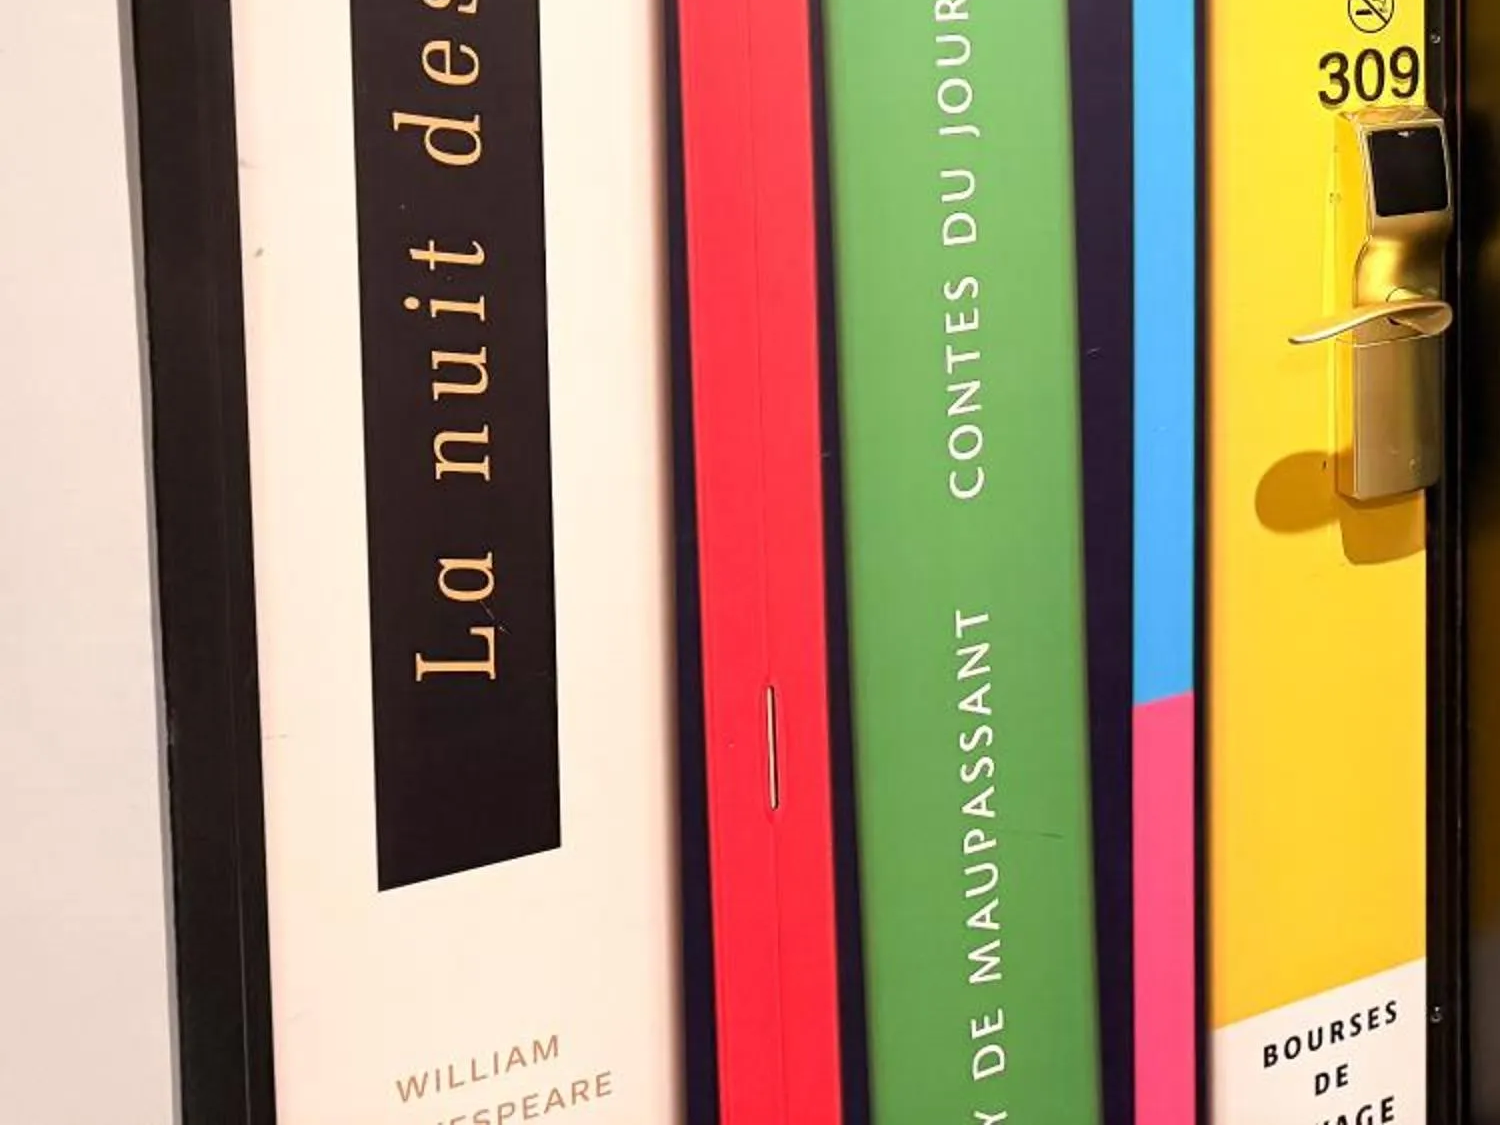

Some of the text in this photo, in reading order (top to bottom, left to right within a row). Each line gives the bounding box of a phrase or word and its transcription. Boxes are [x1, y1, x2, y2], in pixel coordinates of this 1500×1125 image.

[1318, 45, 1419, 105] 309
[940, 168, 978, 247] DU
[403, 239, 491, 483] nuit
[944, 276, 985, 501] CONTES
[415, 551, 498, 682] La
[955, 608, 1003, 985] MAUPASSANT
[396, 1034, 559, 1103] WILLIAM
[970, 1007, 1006, 1082] DE
[1262, 1000, 1398, 1069] BOURSES
[1314, 1064, 1349, 1096] DE
